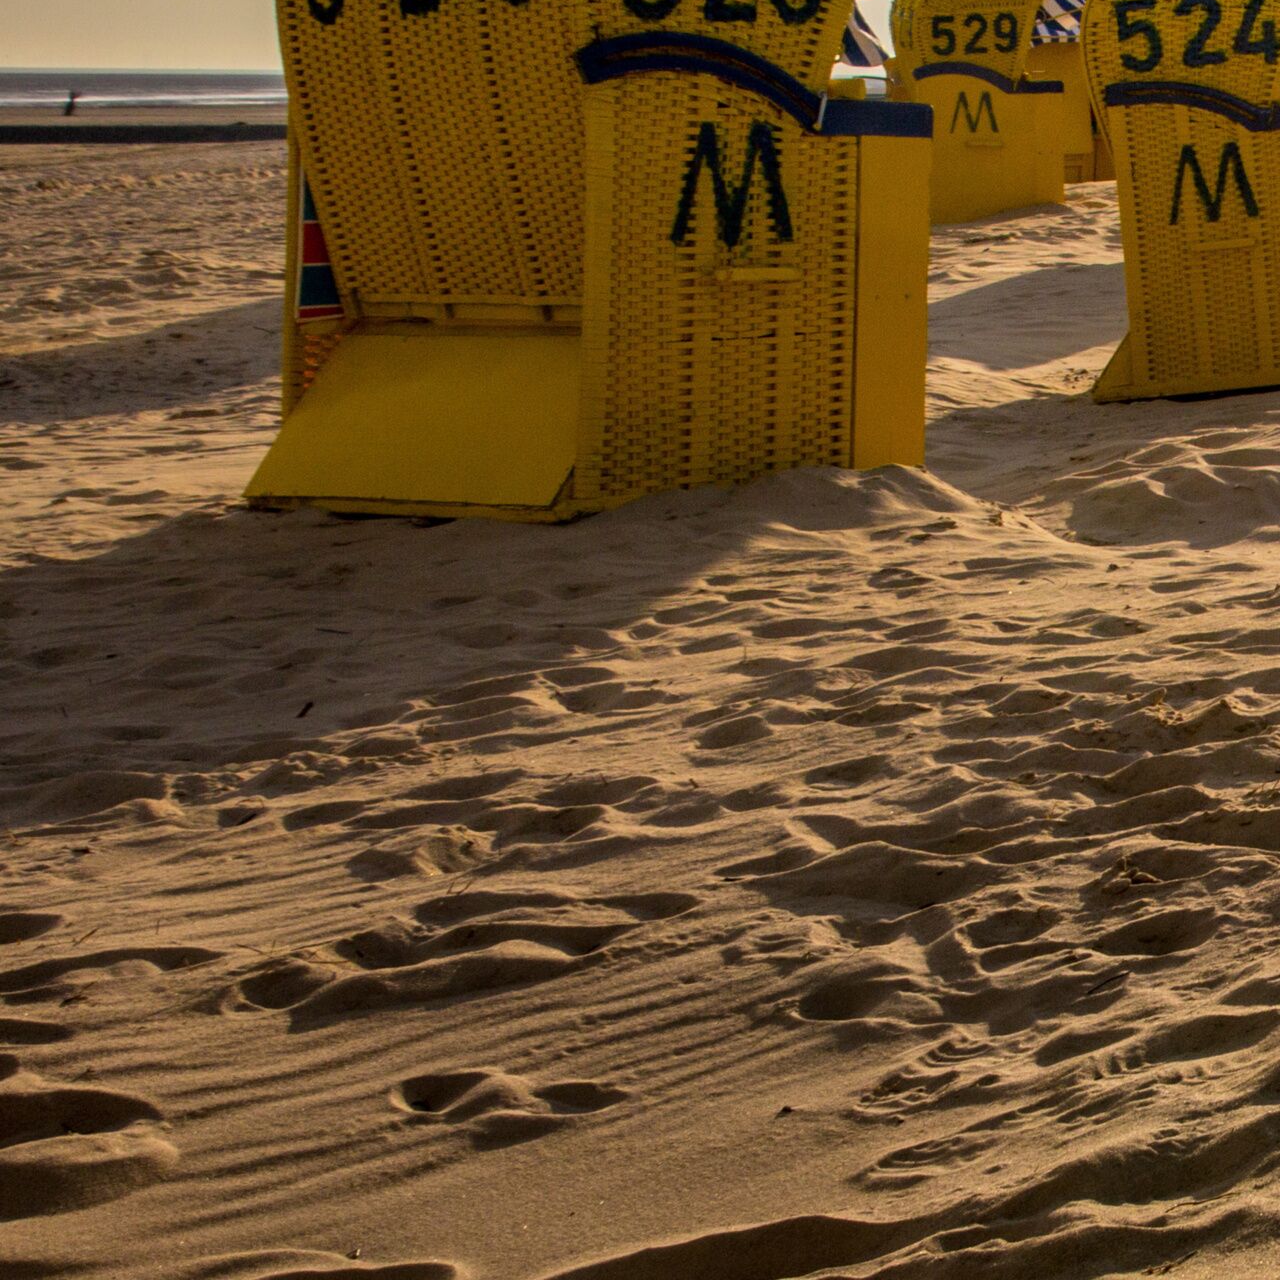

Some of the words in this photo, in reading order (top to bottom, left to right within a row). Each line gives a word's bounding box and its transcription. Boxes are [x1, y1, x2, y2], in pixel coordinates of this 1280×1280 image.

[931, 12, 1018, 56] 529
[950, 91, 999, 134] M
[670, 120, 795, 248] M
[1171, 142, 1260, 226] M
